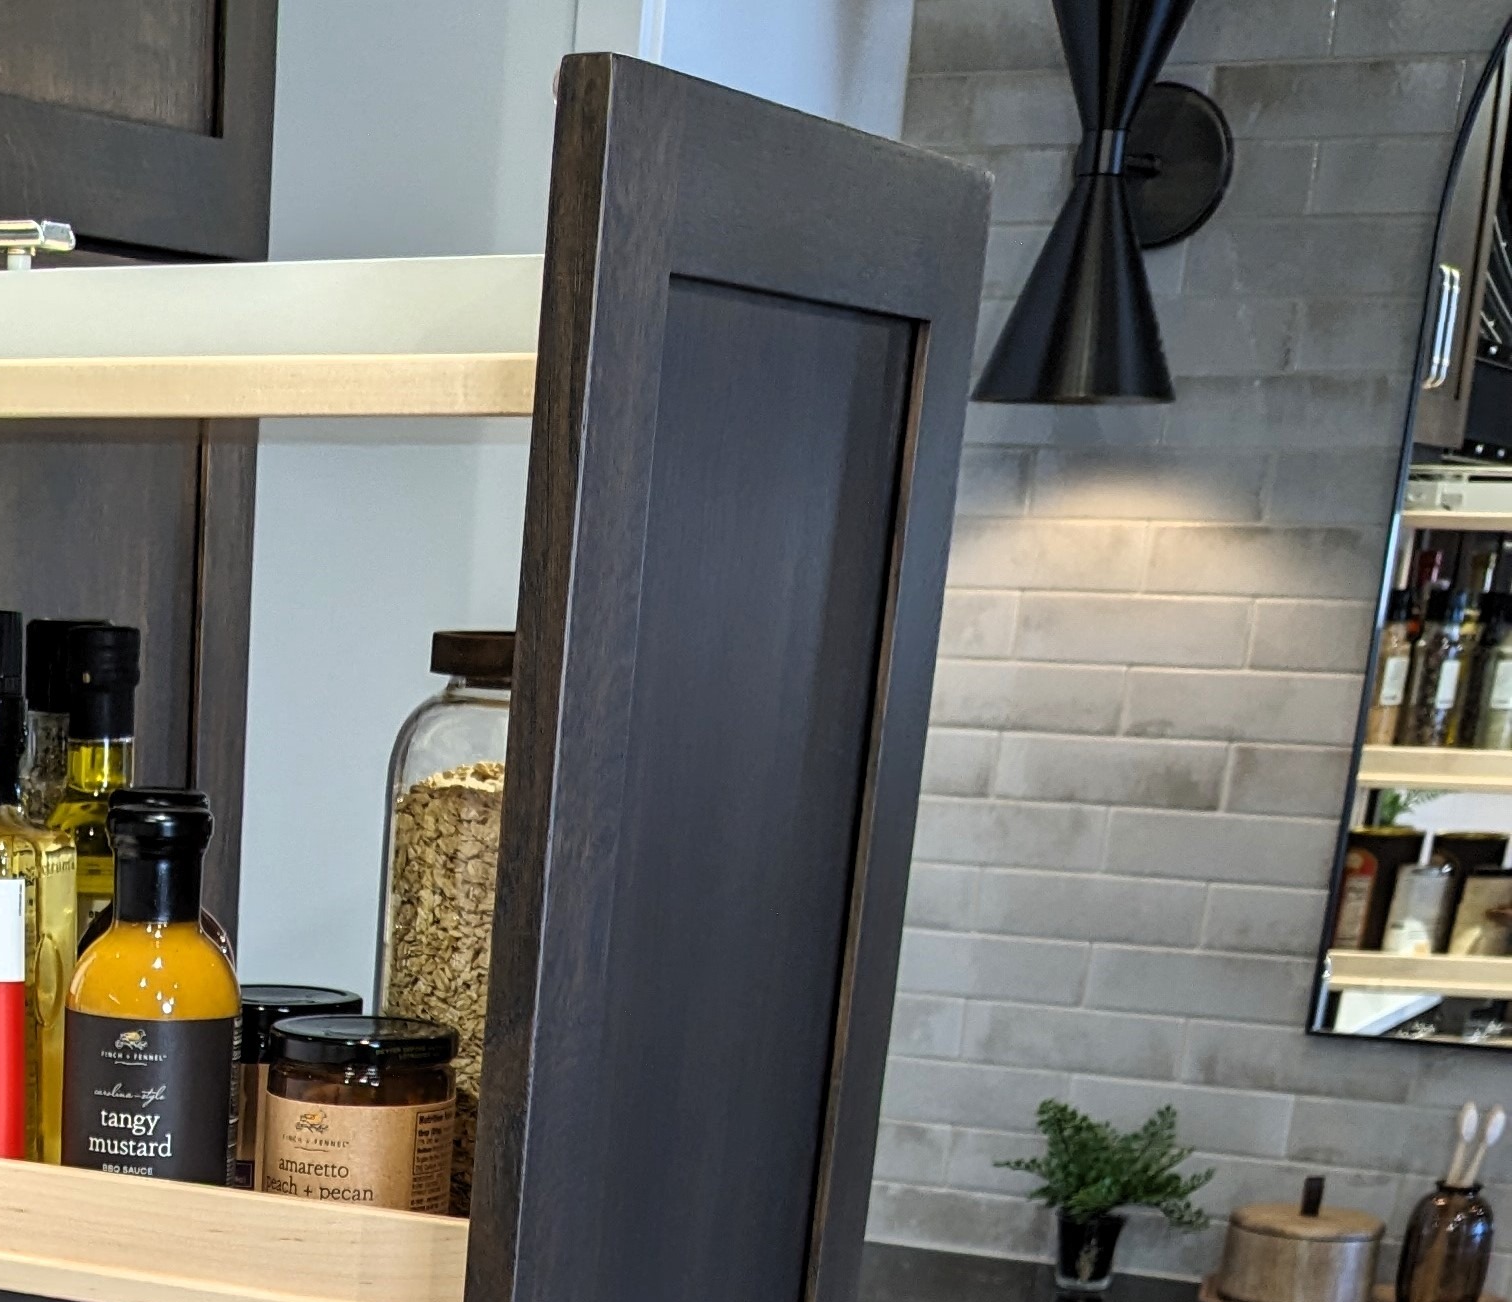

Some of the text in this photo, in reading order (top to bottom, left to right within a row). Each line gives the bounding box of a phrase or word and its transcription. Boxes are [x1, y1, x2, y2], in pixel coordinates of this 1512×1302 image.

[100, 1050, 123, 1060] FINCH
[100, 1110, 160, 1136] tangy
[88, 1133, 173, 1158] mustard
[102, 1163, 153, 1176] BBQ SAUCE
[278, 1156, 350, 1179] amaretto
[266, 1175, 298, 1196] peach
[319, 1186, 374, 1201] pecan
